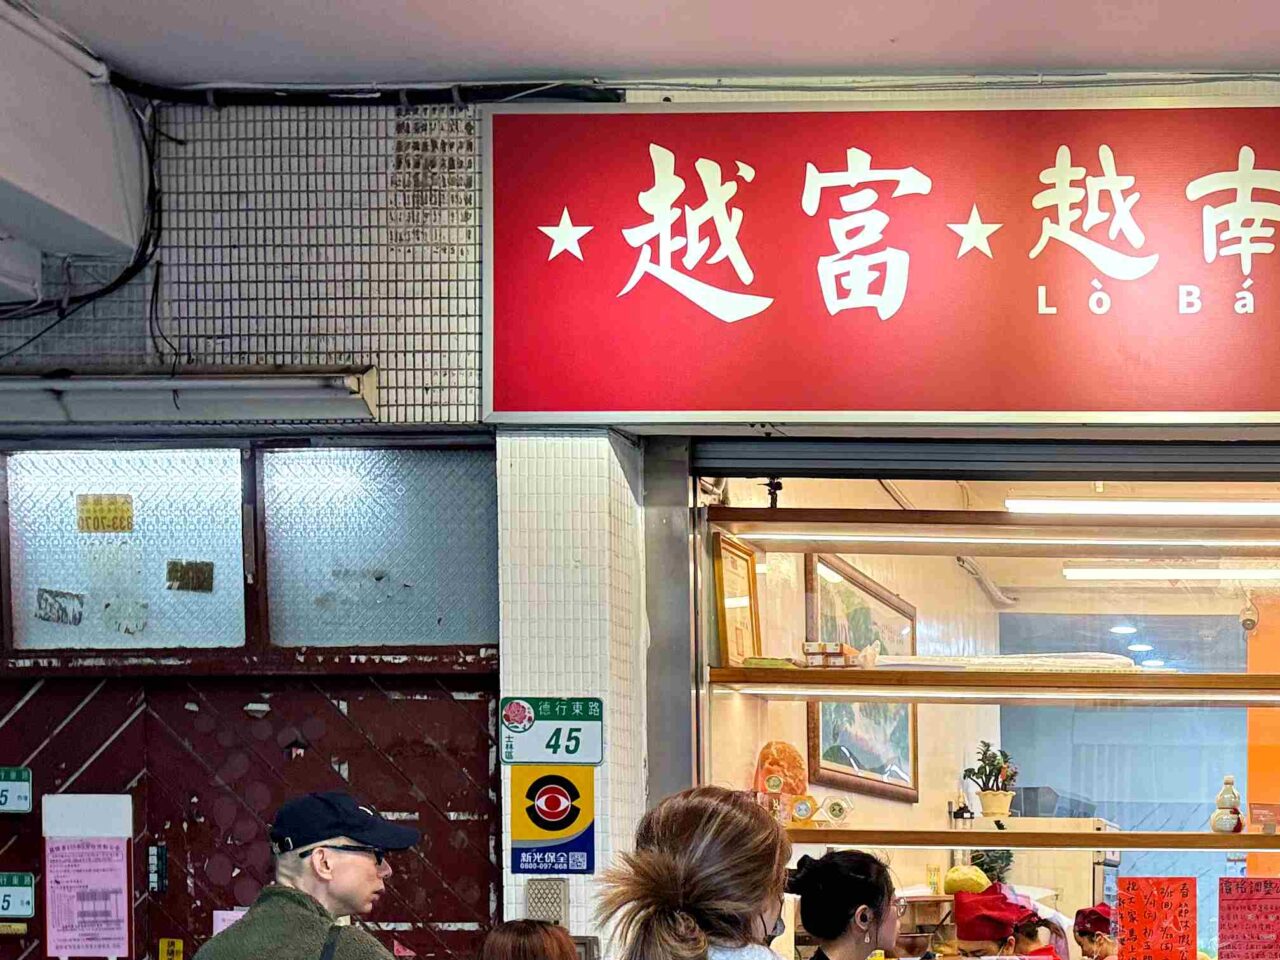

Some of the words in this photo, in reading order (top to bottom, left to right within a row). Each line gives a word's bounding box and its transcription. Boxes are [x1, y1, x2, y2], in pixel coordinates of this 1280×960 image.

[617, 143, 932, 323] 越富
[1038, 280, 1111, 315] Lò
[538, 701, 600, 717] 德行東路
[504, 734, 515, 760] 士林區
[545, 727, 583, 755] 45
[520, 852, 568, 864] 新光保全
[1, 894, 12, 911] 5
